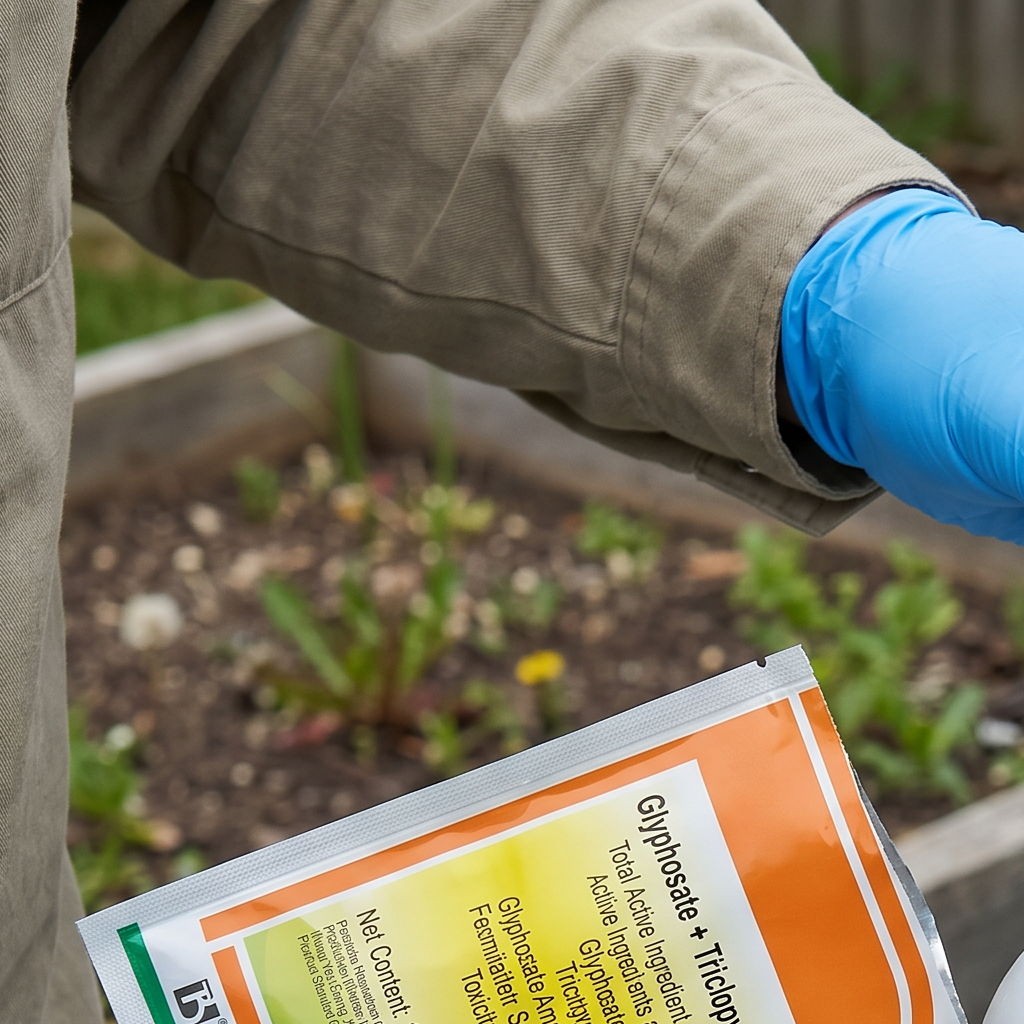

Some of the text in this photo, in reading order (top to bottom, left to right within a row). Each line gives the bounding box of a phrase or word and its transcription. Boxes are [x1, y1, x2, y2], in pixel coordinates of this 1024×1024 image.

[609, 839, 642, 884] Total
[637, 794, 700, 922] Glyphosate
[689, 926, 709, 940] +
[356, 908, 385, 944] Net
[623, 888, 655, 939] Active
[370, 945, 411, 1019] Content:
[644, 939, 693, 1024] Ingredient
